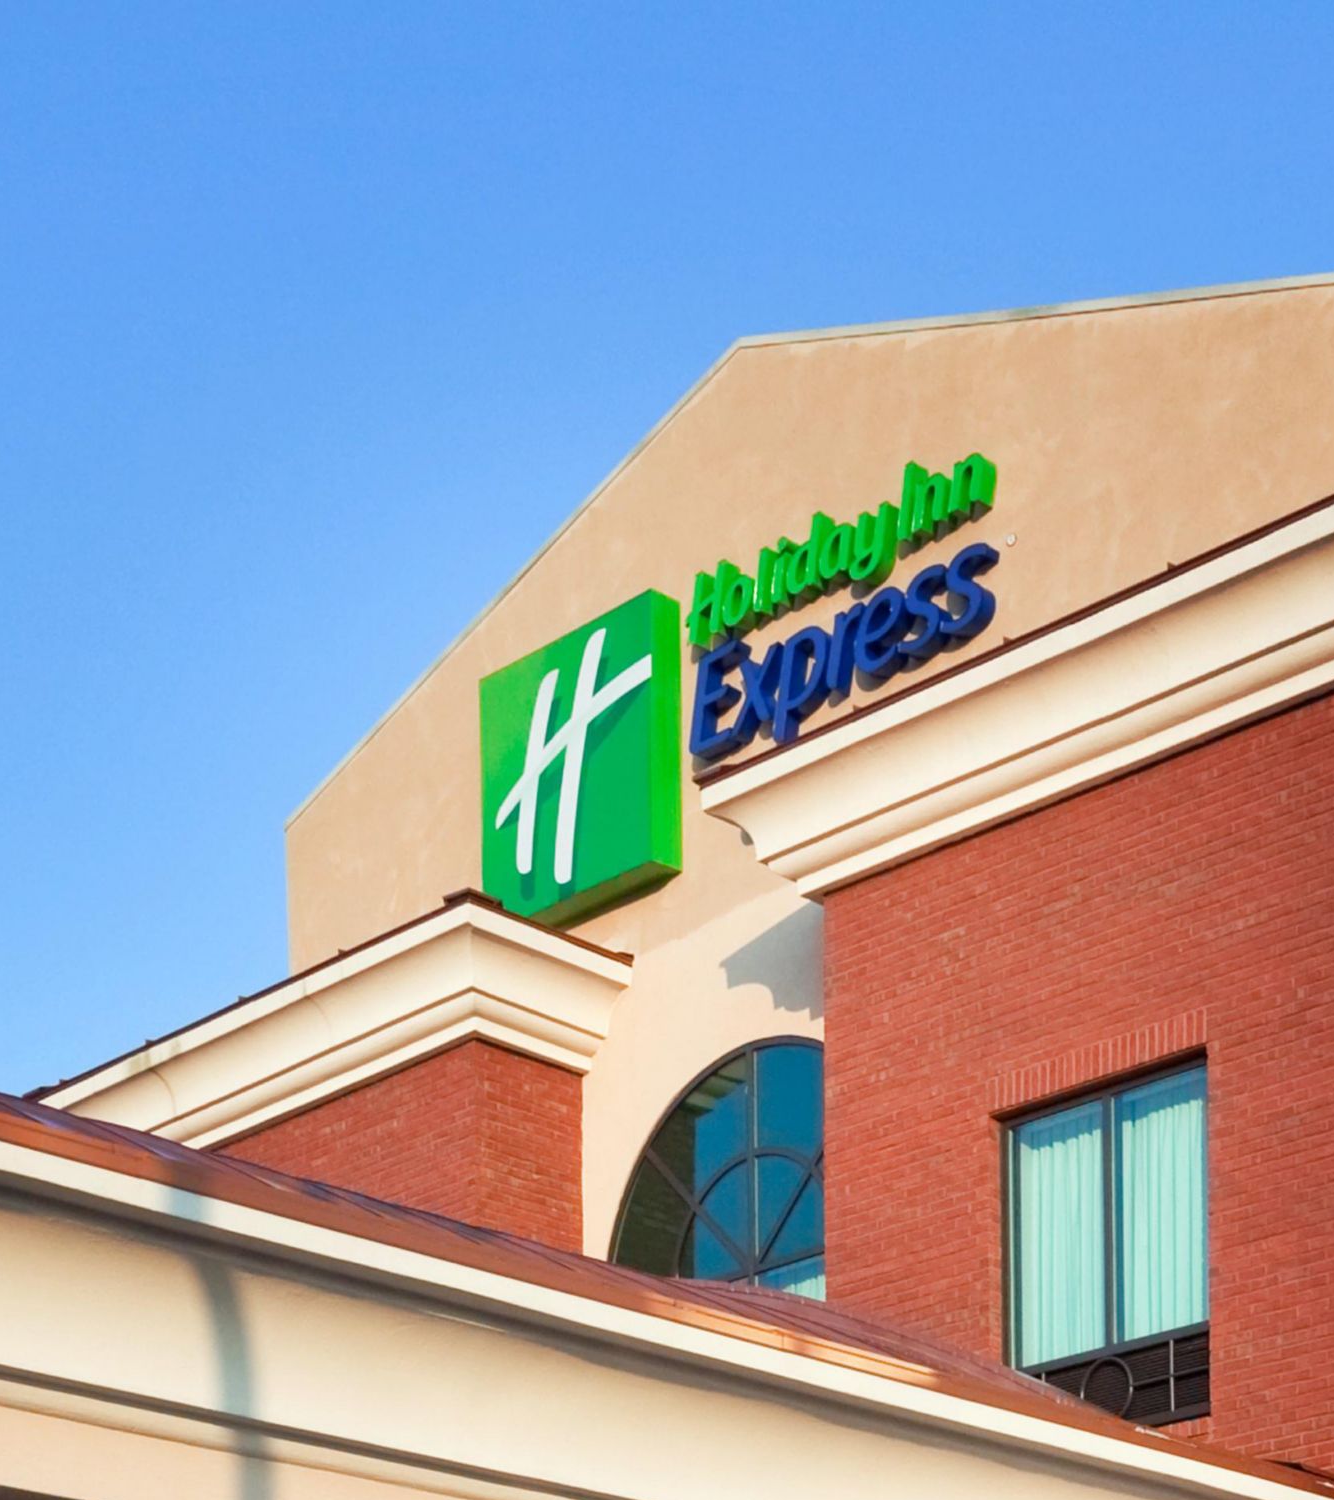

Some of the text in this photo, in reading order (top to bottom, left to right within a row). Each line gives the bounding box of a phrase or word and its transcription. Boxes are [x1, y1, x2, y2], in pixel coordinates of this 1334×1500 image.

[686, 452, 997, 649] Holiday Inn
[689, 542, 1000, 760] Express
[495, 627, 652, 885] H
